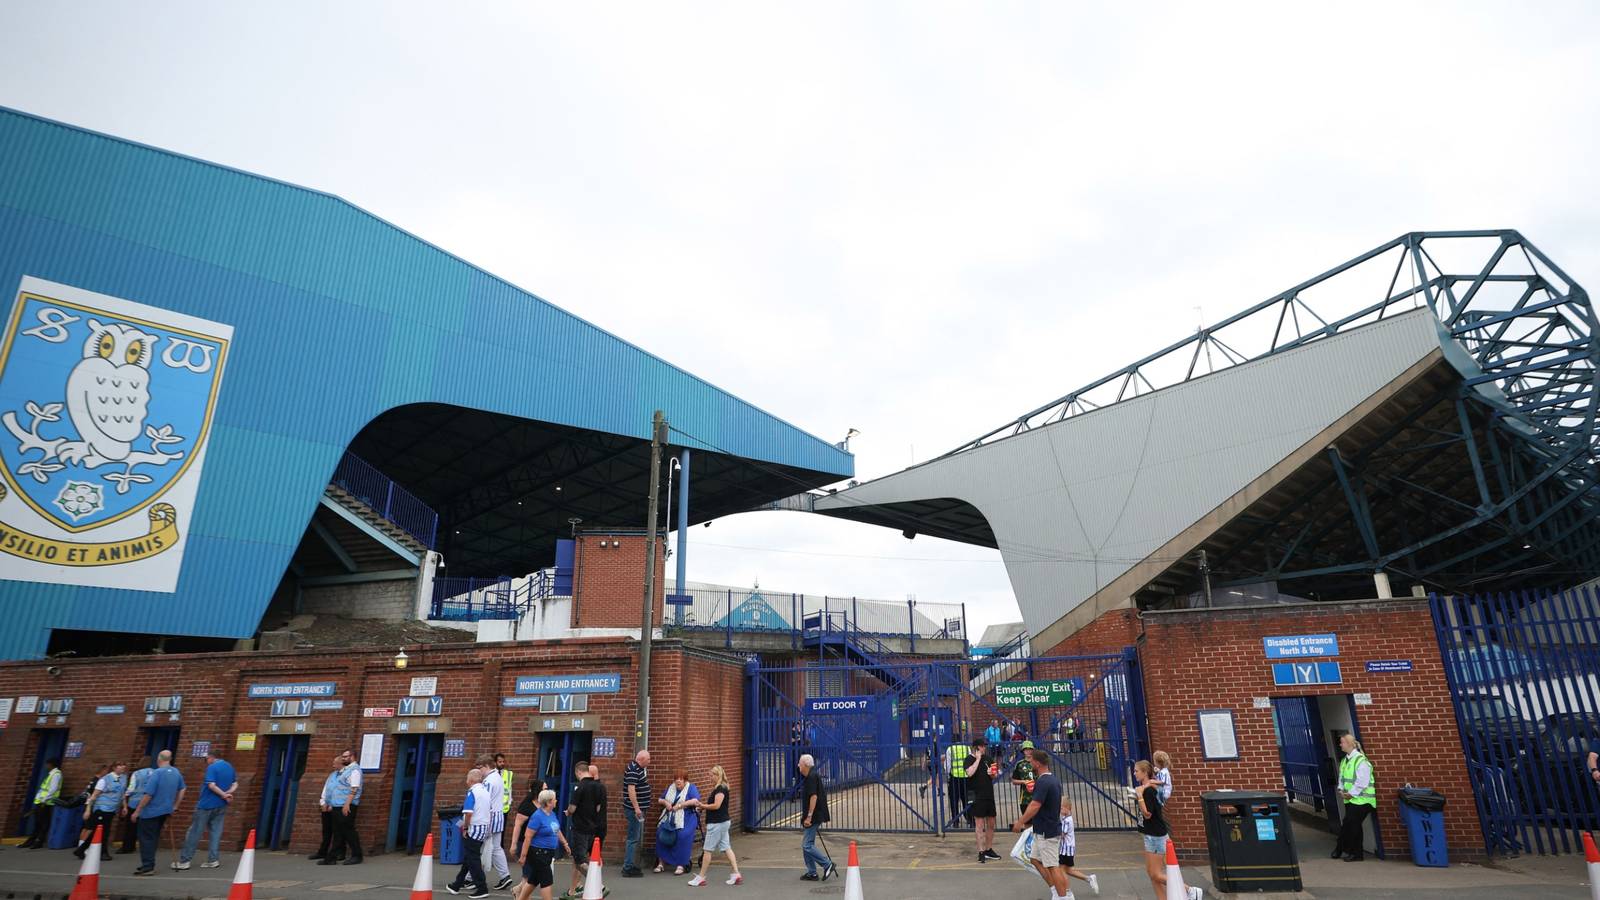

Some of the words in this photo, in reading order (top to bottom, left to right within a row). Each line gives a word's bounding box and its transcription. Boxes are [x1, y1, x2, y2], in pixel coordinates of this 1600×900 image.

[68, 548, 88, 562] ET
[96, 536, 164, 562] ANIMIS
[1267, 639, 1299, 647] Disabled
[1301, 637, 1333, 645] Entrance
[1280, 647, 1300, 655] North
[1297, 665, 1313, 683] Y
[520, 682, 544, 690] NORTH
[546, 680, 570, 689] STAND
[571, 679, 609, 688] ENTRANCE
[611, 678, 616, 687] Y
[996, 684, 1050, 695] Emergency
[1052, 682, 1071, 692] Exit
[252, 687, 273, 695] NORTH
[293, 686, 325, 694] ENTRANCE
[326, 686, 331, 694] Y
[403, 699, 412, 712] Y
[431, 698, 440, 712] Y
[560, 694, 570, 709] Y
[859, 701, 867, 709] 17
[997, 695, 1022, 705] Keep
[1024, 694, 1050, 703] Clear
[276, 700, 285, 714] Y
[302, 699, 310, 714] Y
